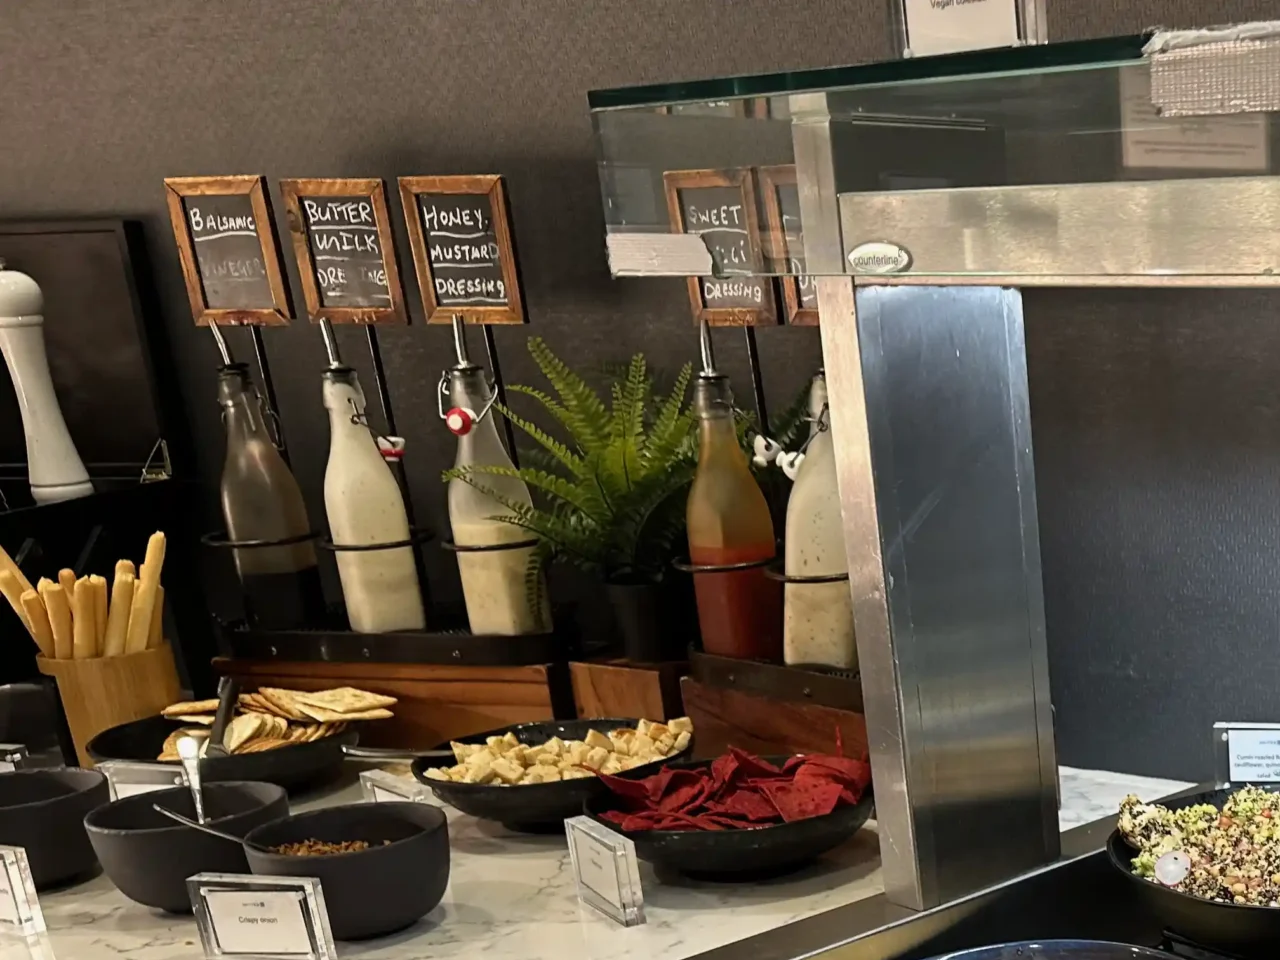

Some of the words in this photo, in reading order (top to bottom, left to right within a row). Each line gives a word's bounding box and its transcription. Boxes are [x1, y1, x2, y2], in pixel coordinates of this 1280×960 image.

[190, 207, 256, 231] BALSAMIC
[304, 200, 372, 224] BUTTER
[689, 205, 741, 225] SWEET
[430, 242, 499, 262] MUSTARD
[853, 254, 899, 267] counterline
[317, 266, 388, 287] DREING
